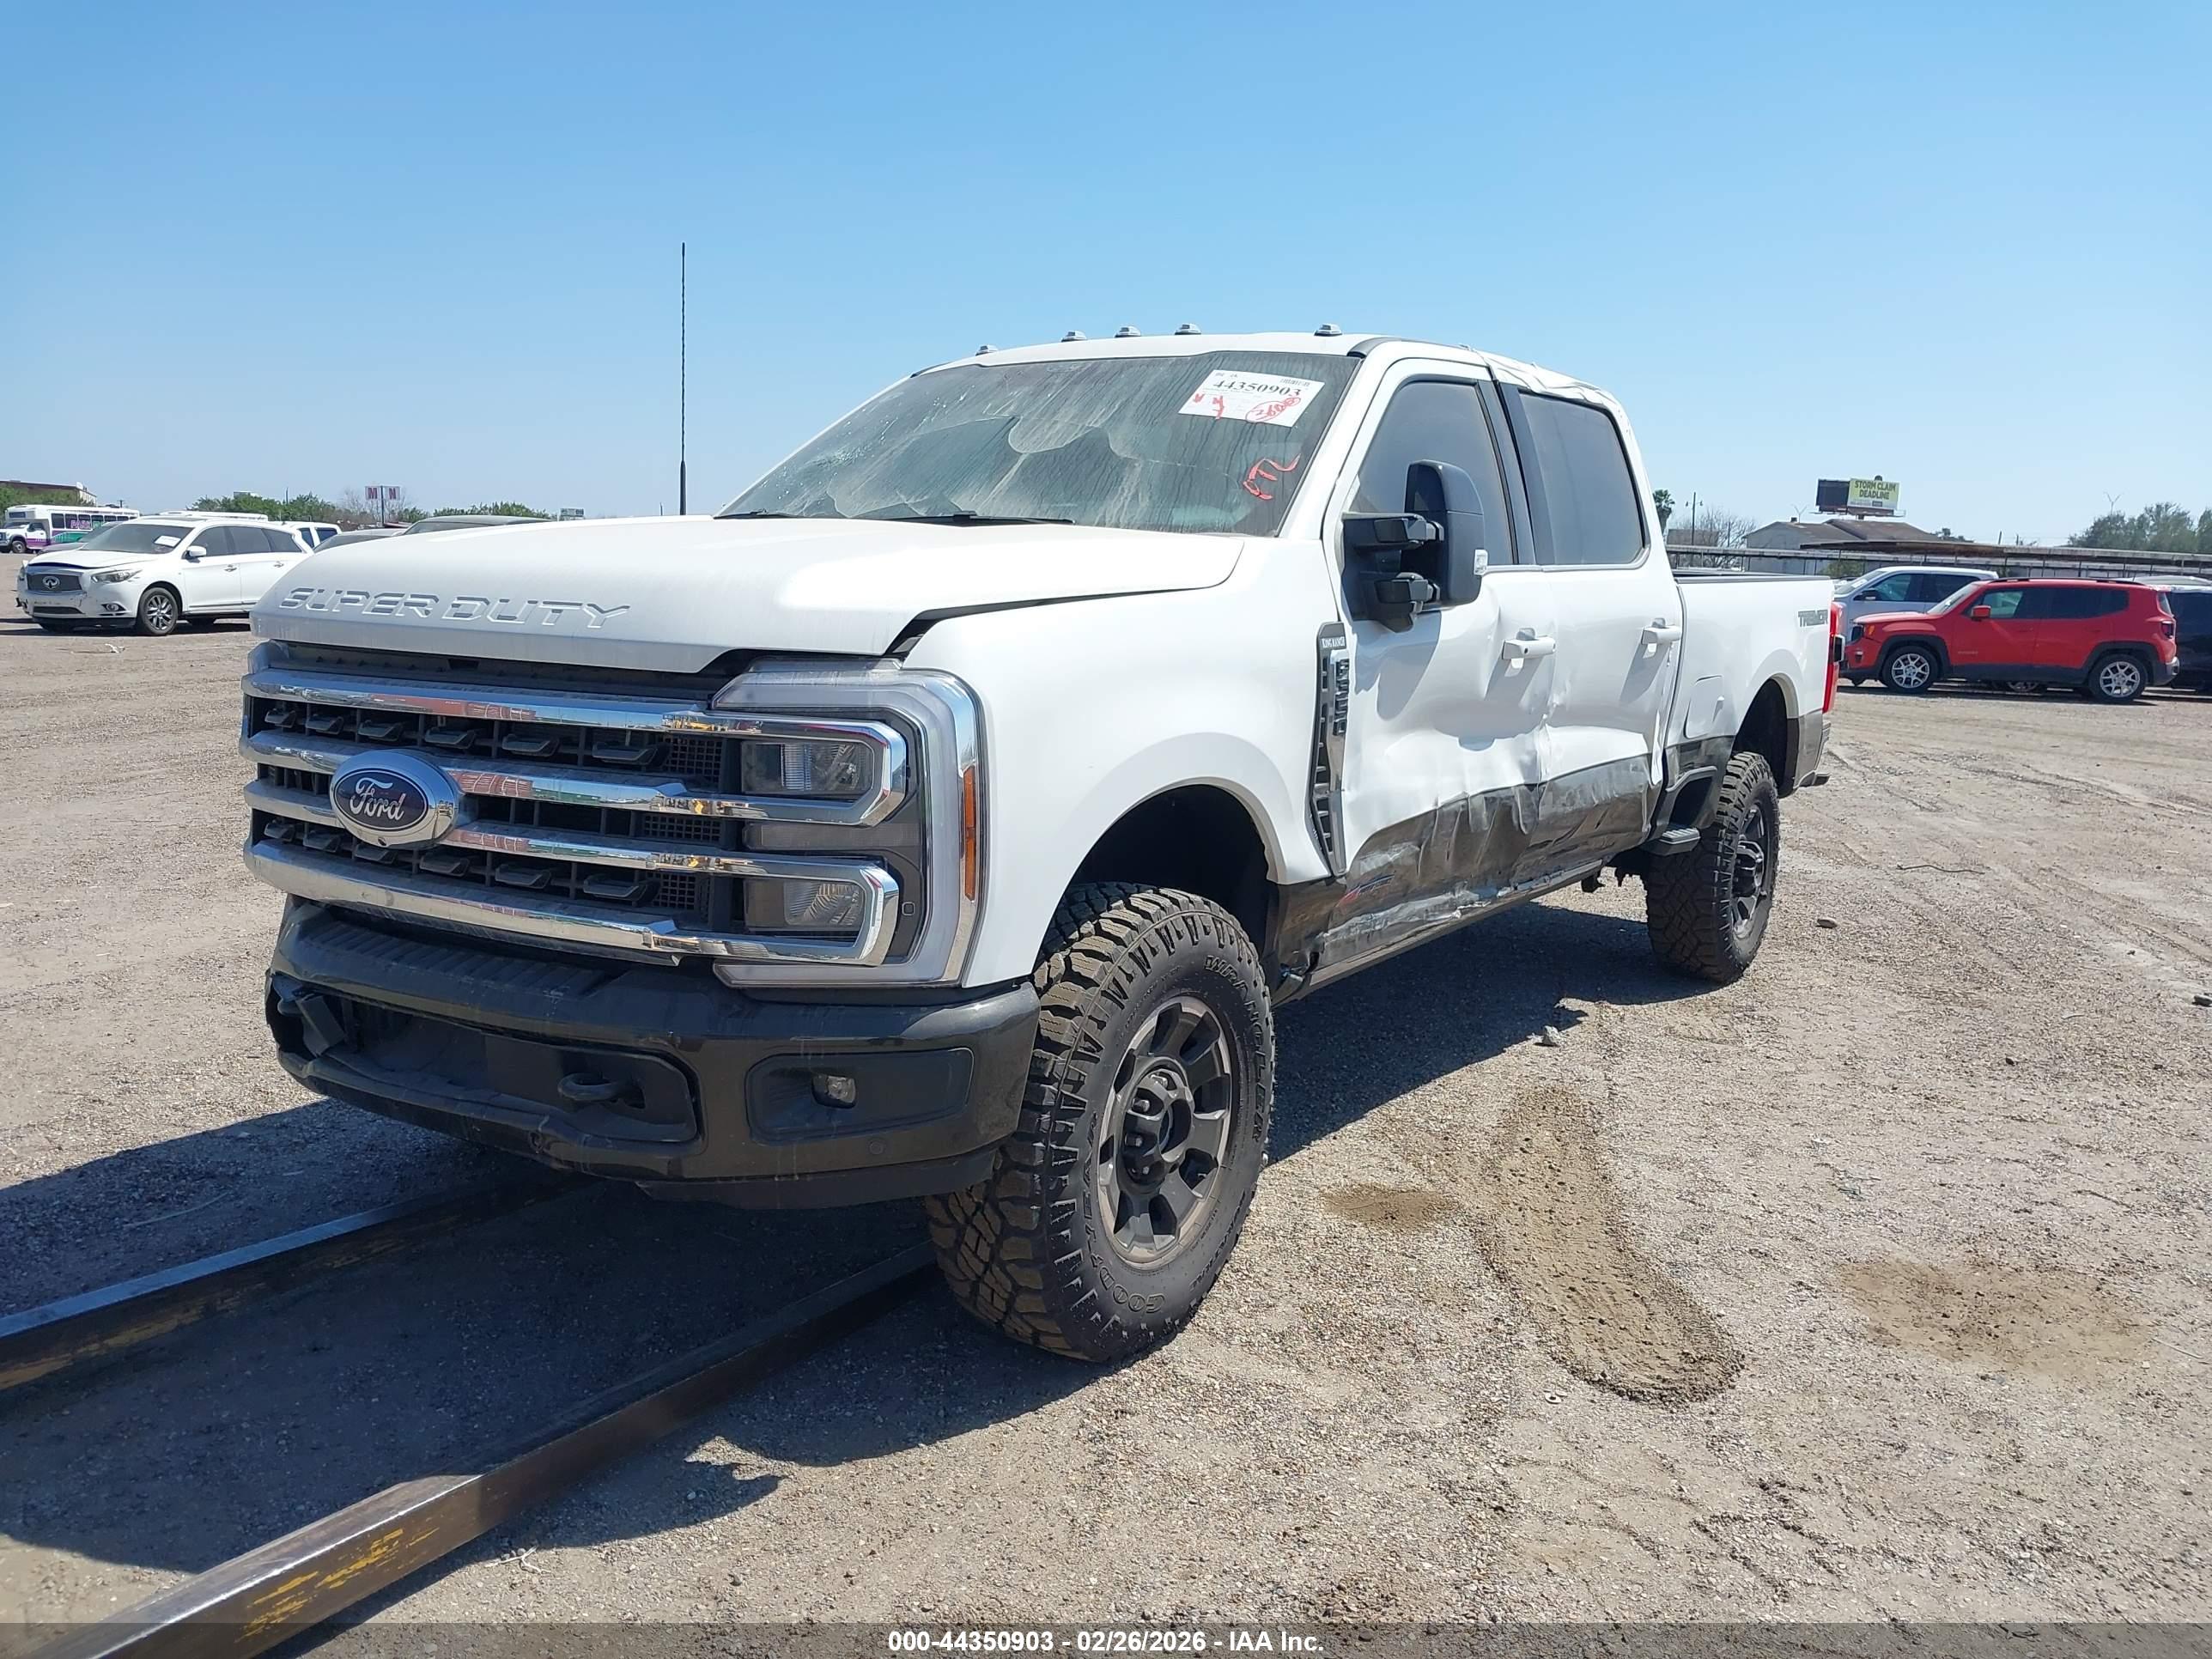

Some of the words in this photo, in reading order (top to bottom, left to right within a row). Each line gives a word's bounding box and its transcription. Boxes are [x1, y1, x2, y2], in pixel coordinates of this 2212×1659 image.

[1213, 380, 1302, 398] 44350903
[1854, 480, 1876, 490] STORM
[1877, 483, 1897, 492] CLAIM
[1859, 489, 1890, 500] DEADLINE
[278, 586, 440, 619] SUPER
[441, 596, 631, 629] DUTY
[349, 776, 406, 821] Ford
[1204, 953, 1267, 1145] WRANGLER
[1082, 1109, 1166, 1314] GOODYEAR
